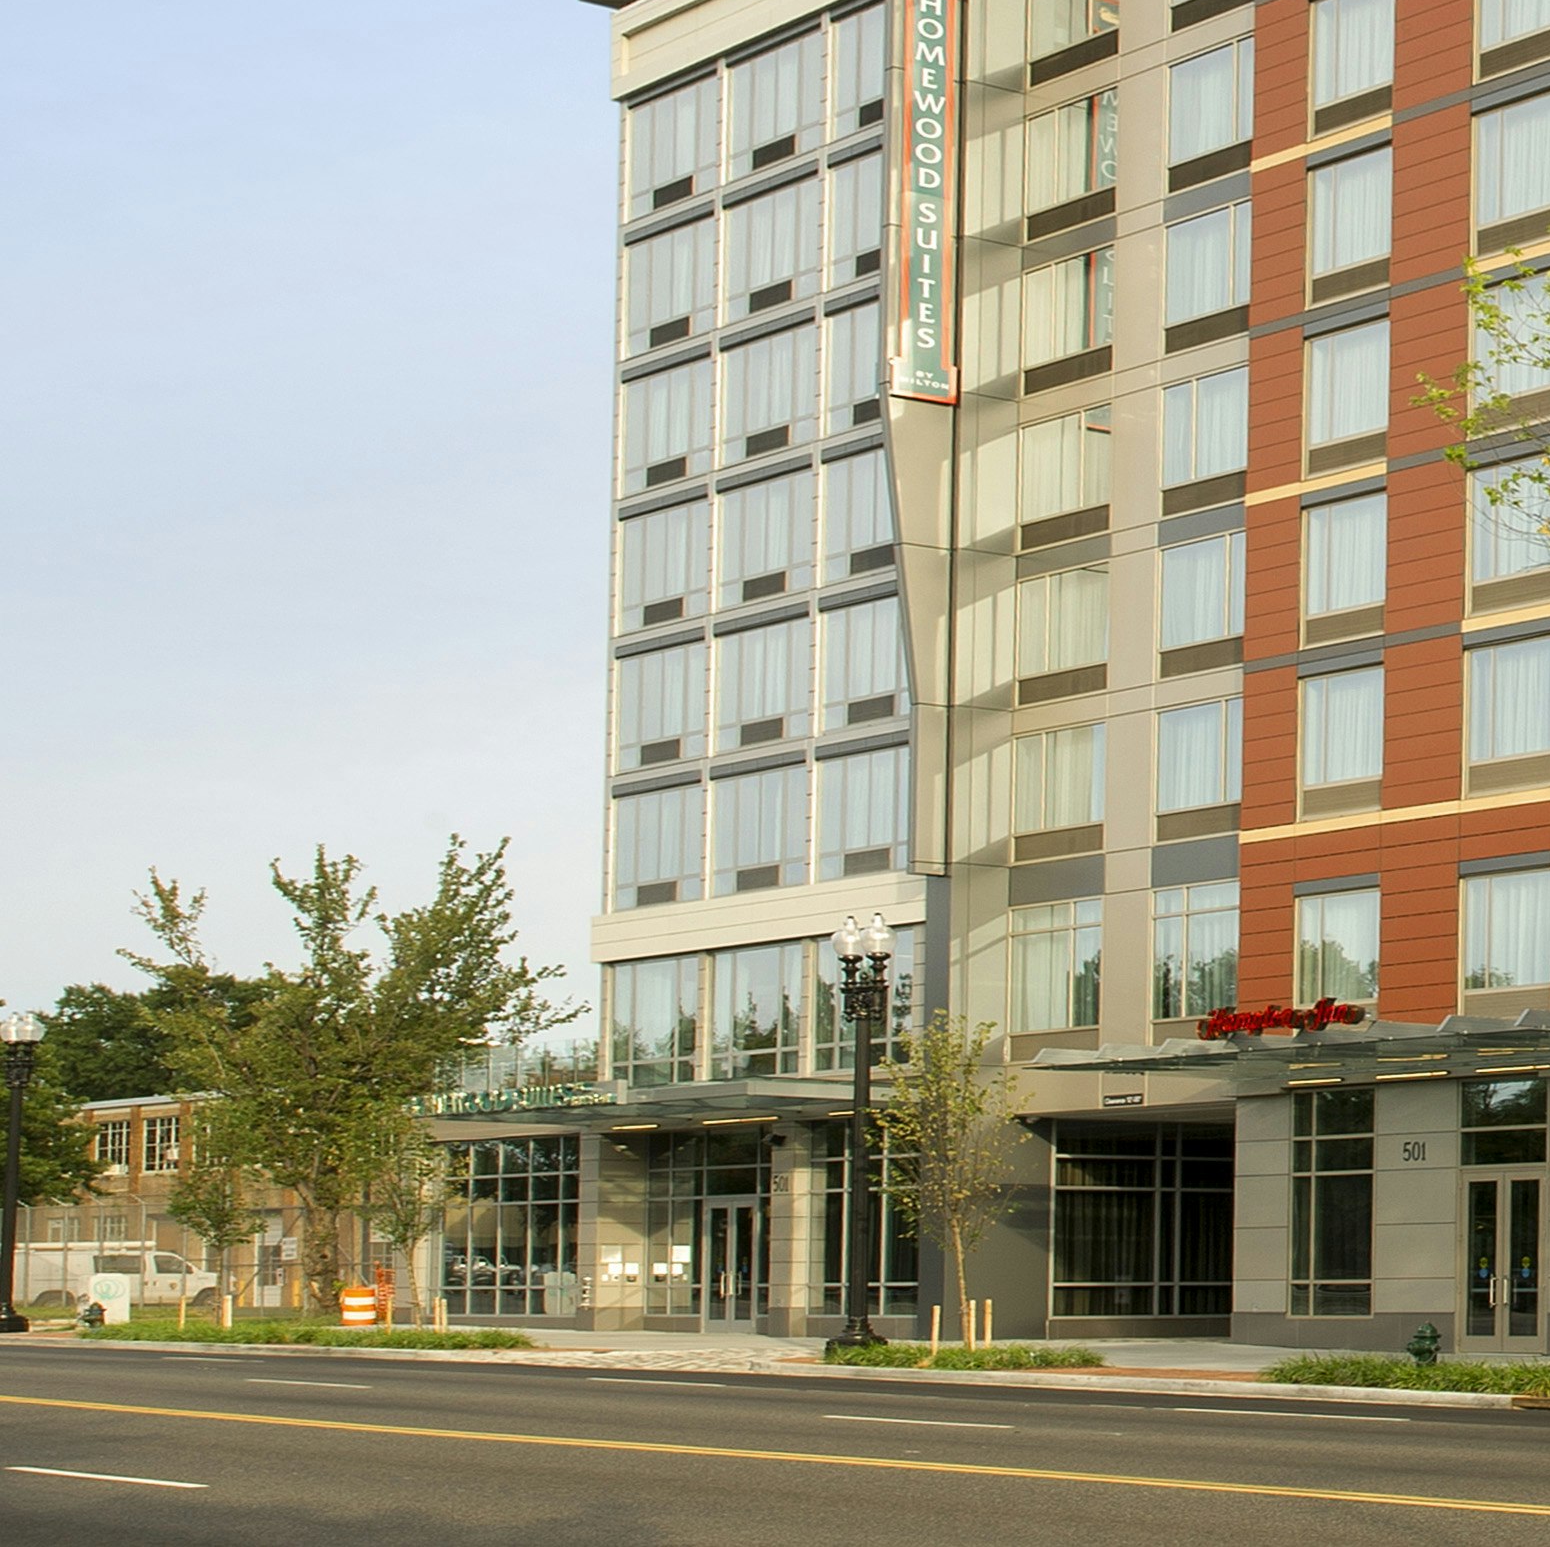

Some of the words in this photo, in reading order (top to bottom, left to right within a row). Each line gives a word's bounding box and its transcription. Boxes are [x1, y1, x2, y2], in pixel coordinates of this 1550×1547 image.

[916, 201, 938, 350] SUITES
[915, 369, 934, 379] BY
[1402, 1141, 1426, 1162] 501
[773, 1174, 789, 1193] 501
